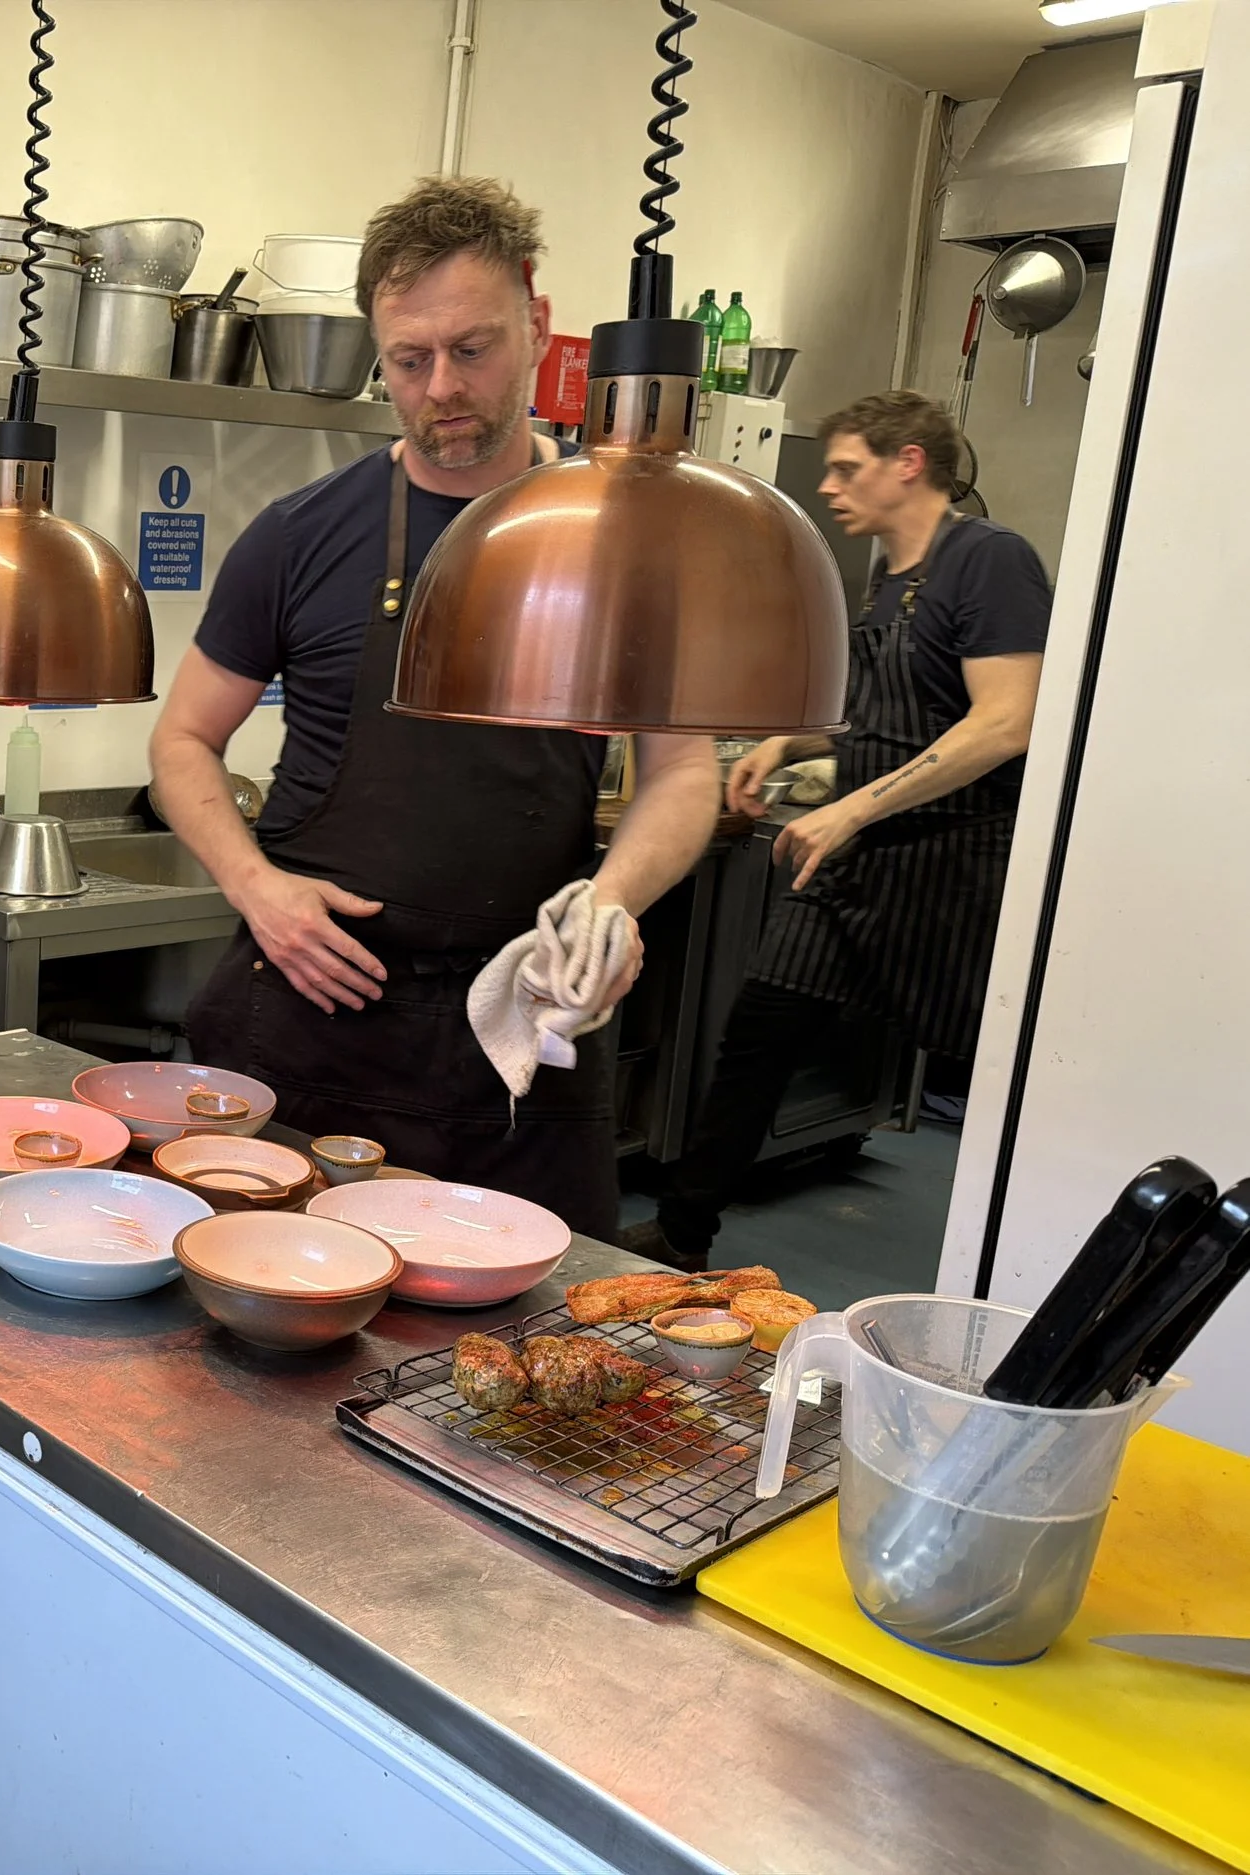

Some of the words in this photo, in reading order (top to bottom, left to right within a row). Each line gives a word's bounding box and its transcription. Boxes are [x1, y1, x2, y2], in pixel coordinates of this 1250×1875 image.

[562, 346, 576, 358] FIRE
[560, 356, 589, 370] BLANKE
[148, 516, 168, 528] Keep
[170, 517, 180, 526] all
[180, 518, 197, 527] cuts
[145, 529, 161, 538] and
[161, 530, 199, 539] abrasions
[147, 541, 179, 550] covered
[180, 541, 197, 550] with
[159, 553, 190, 562] suitable
[150, 563, 192, 574] waterproof
[153, 575, 187, 586] dressing
